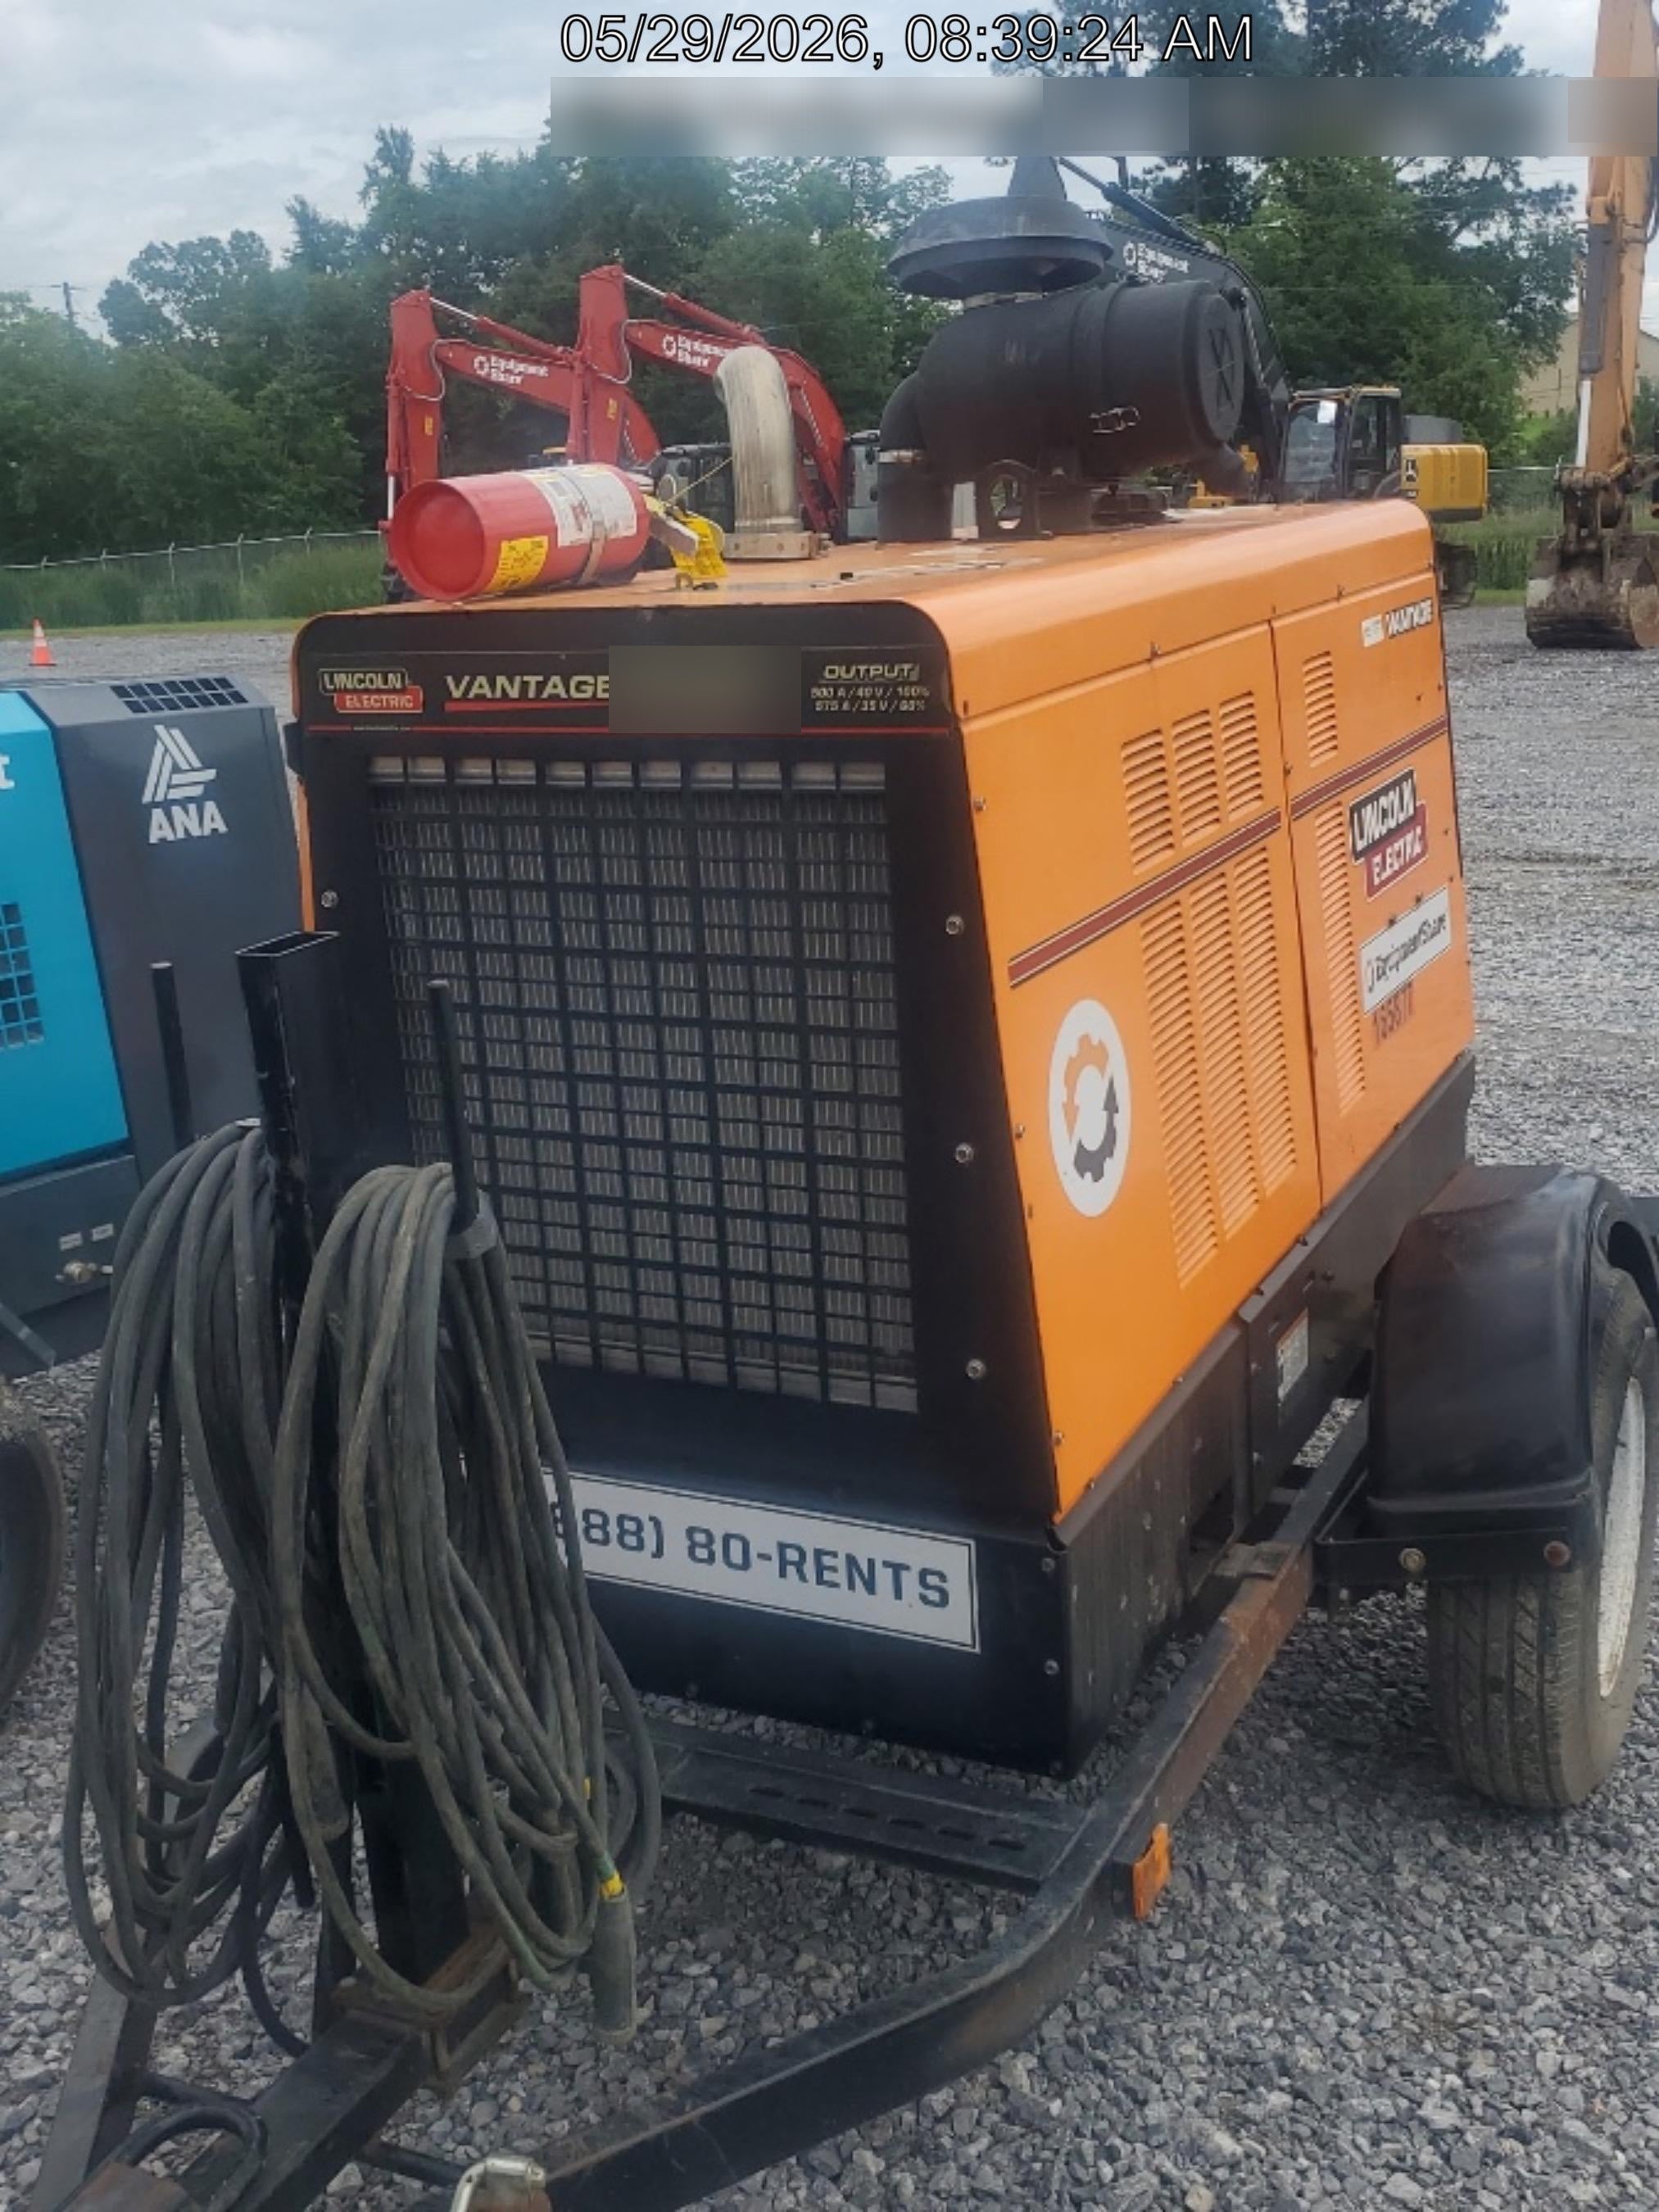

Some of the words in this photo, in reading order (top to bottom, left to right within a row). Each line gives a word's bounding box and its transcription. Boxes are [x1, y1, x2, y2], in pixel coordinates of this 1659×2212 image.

[323, 671, 403, 691] LINCOLN
[823, 664, 918, 680] OUTPUT
[446, 674, 610, 700] VANTAGE
[345, 694, 414, 709] ELECTRIC
[148, 800, 229, 845] ANA
[1353, 778, 1415, 852] LINCOLN
[684, 1525, 950, 1609] 80-RENTS
